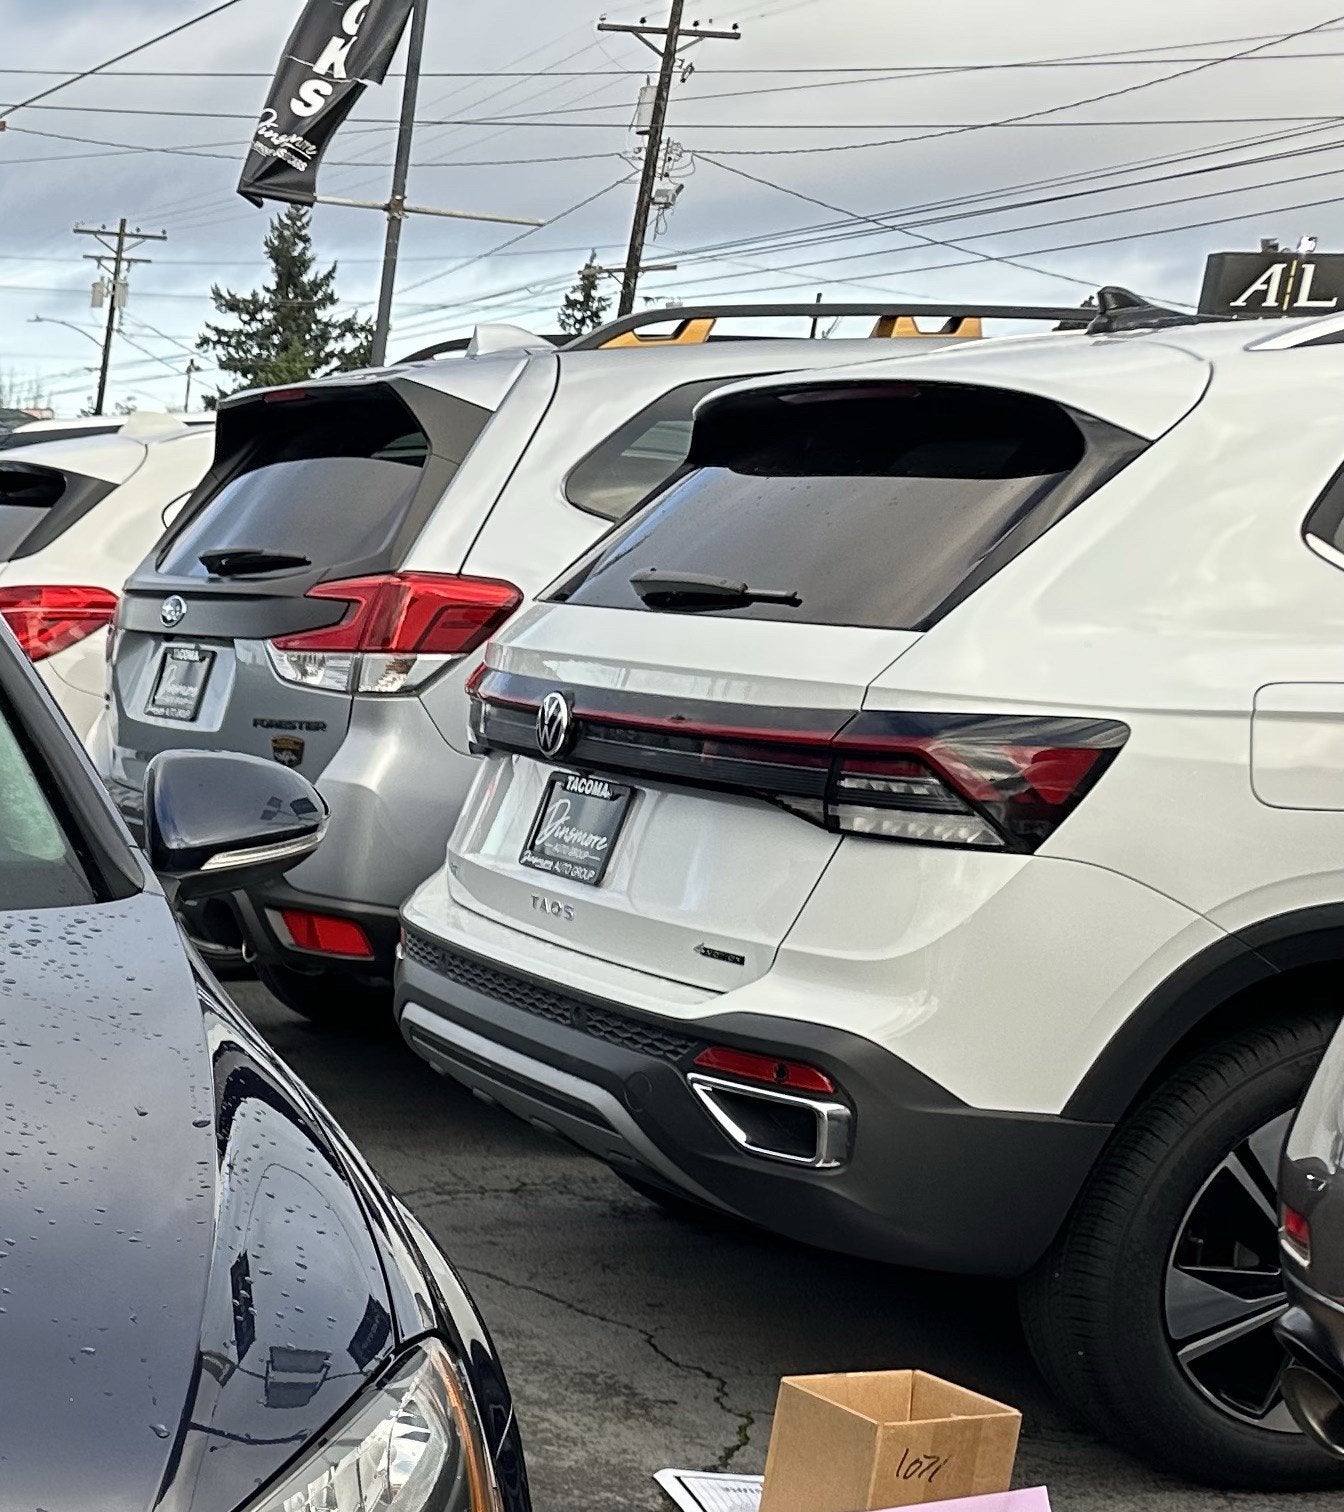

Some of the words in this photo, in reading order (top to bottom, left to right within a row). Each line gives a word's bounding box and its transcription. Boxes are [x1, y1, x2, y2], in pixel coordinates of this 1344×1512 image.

[565, 776, 612, 799] TACOMA
[534, 798, 609, 851] Dinsmore
[530, 894, 576, 921] TAOS
